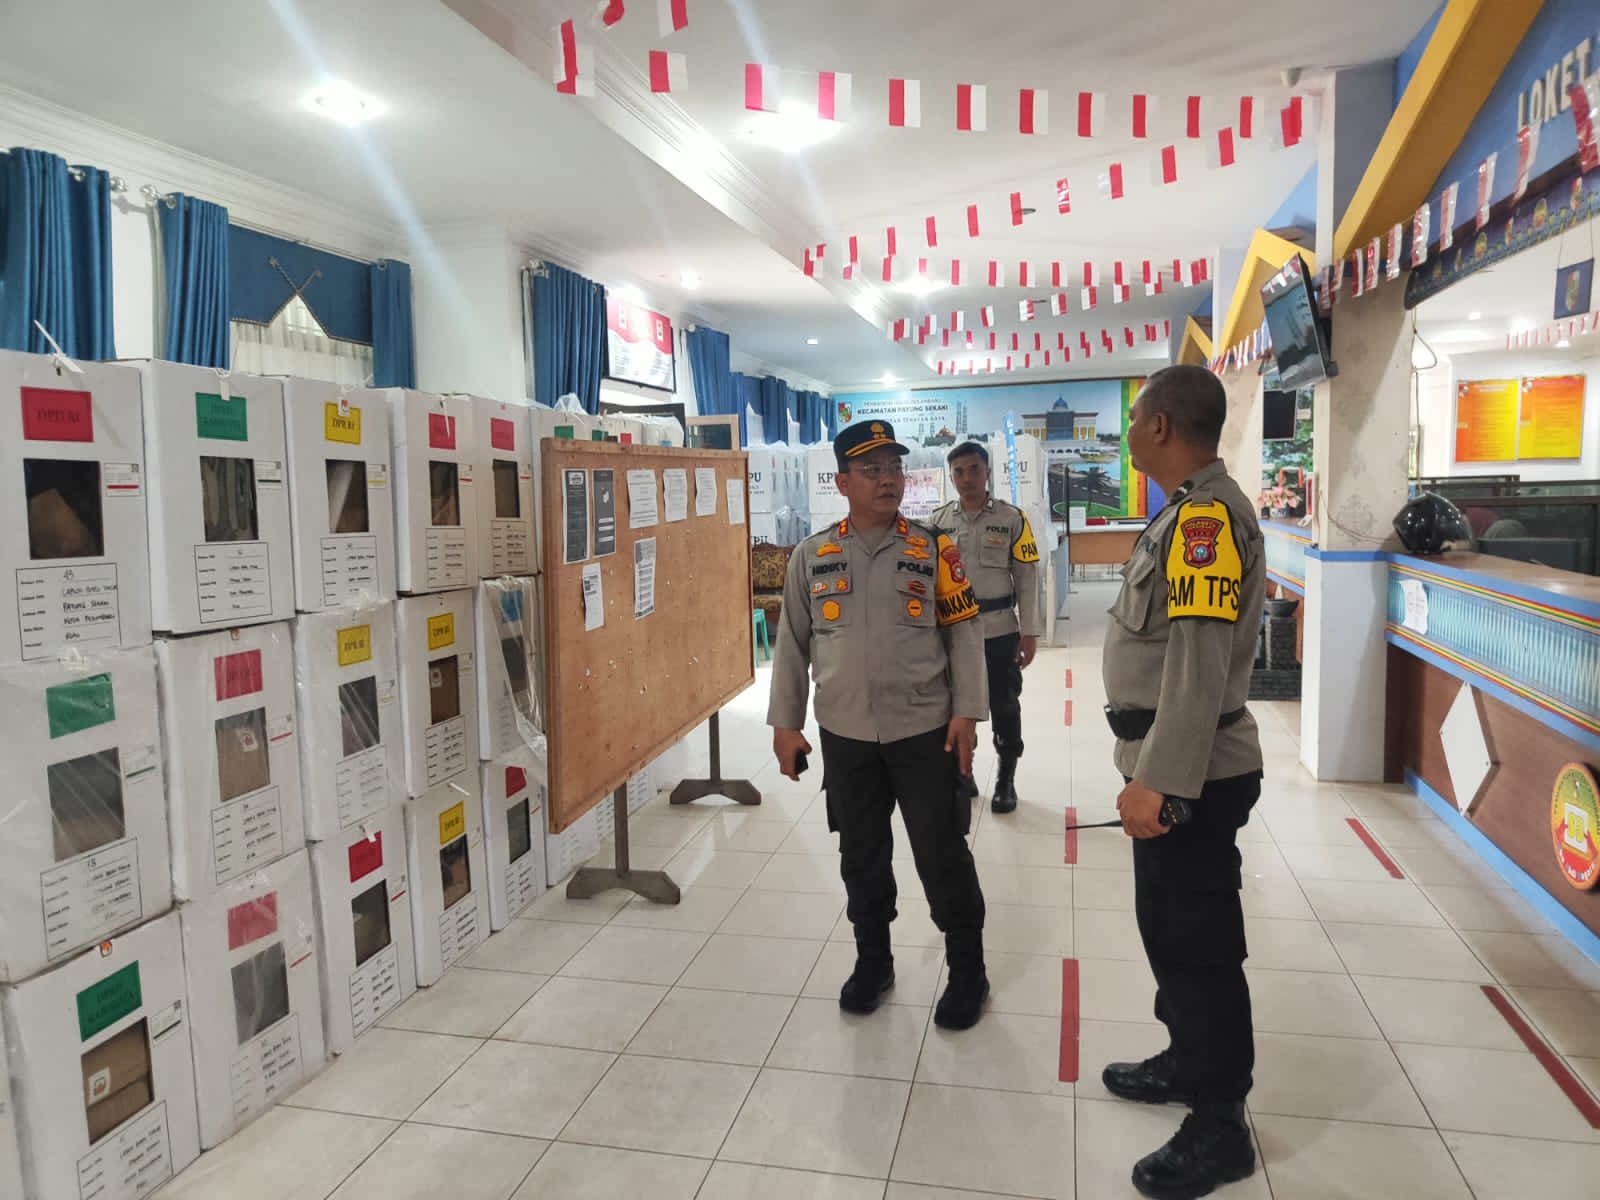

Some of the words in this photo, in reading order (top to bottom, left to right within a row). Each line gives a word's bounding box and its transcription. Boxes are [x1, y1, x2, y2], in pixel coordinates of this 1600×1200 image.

[1517, 37, 1590, 131] LOKET
[857, 406, 897, 415] KECAMATAN
[897, 405, 923, 413] PAYUNG
[924, 403, 949, 412] SEKAKI
[1003, 461, 1028, 475] KU
[817, 471, 837, 484] KP
[897, 561, 934, 577] POLRI
[1167, 574, 1195, 609] AM
[1203, 575, 1239, 611] TPS
